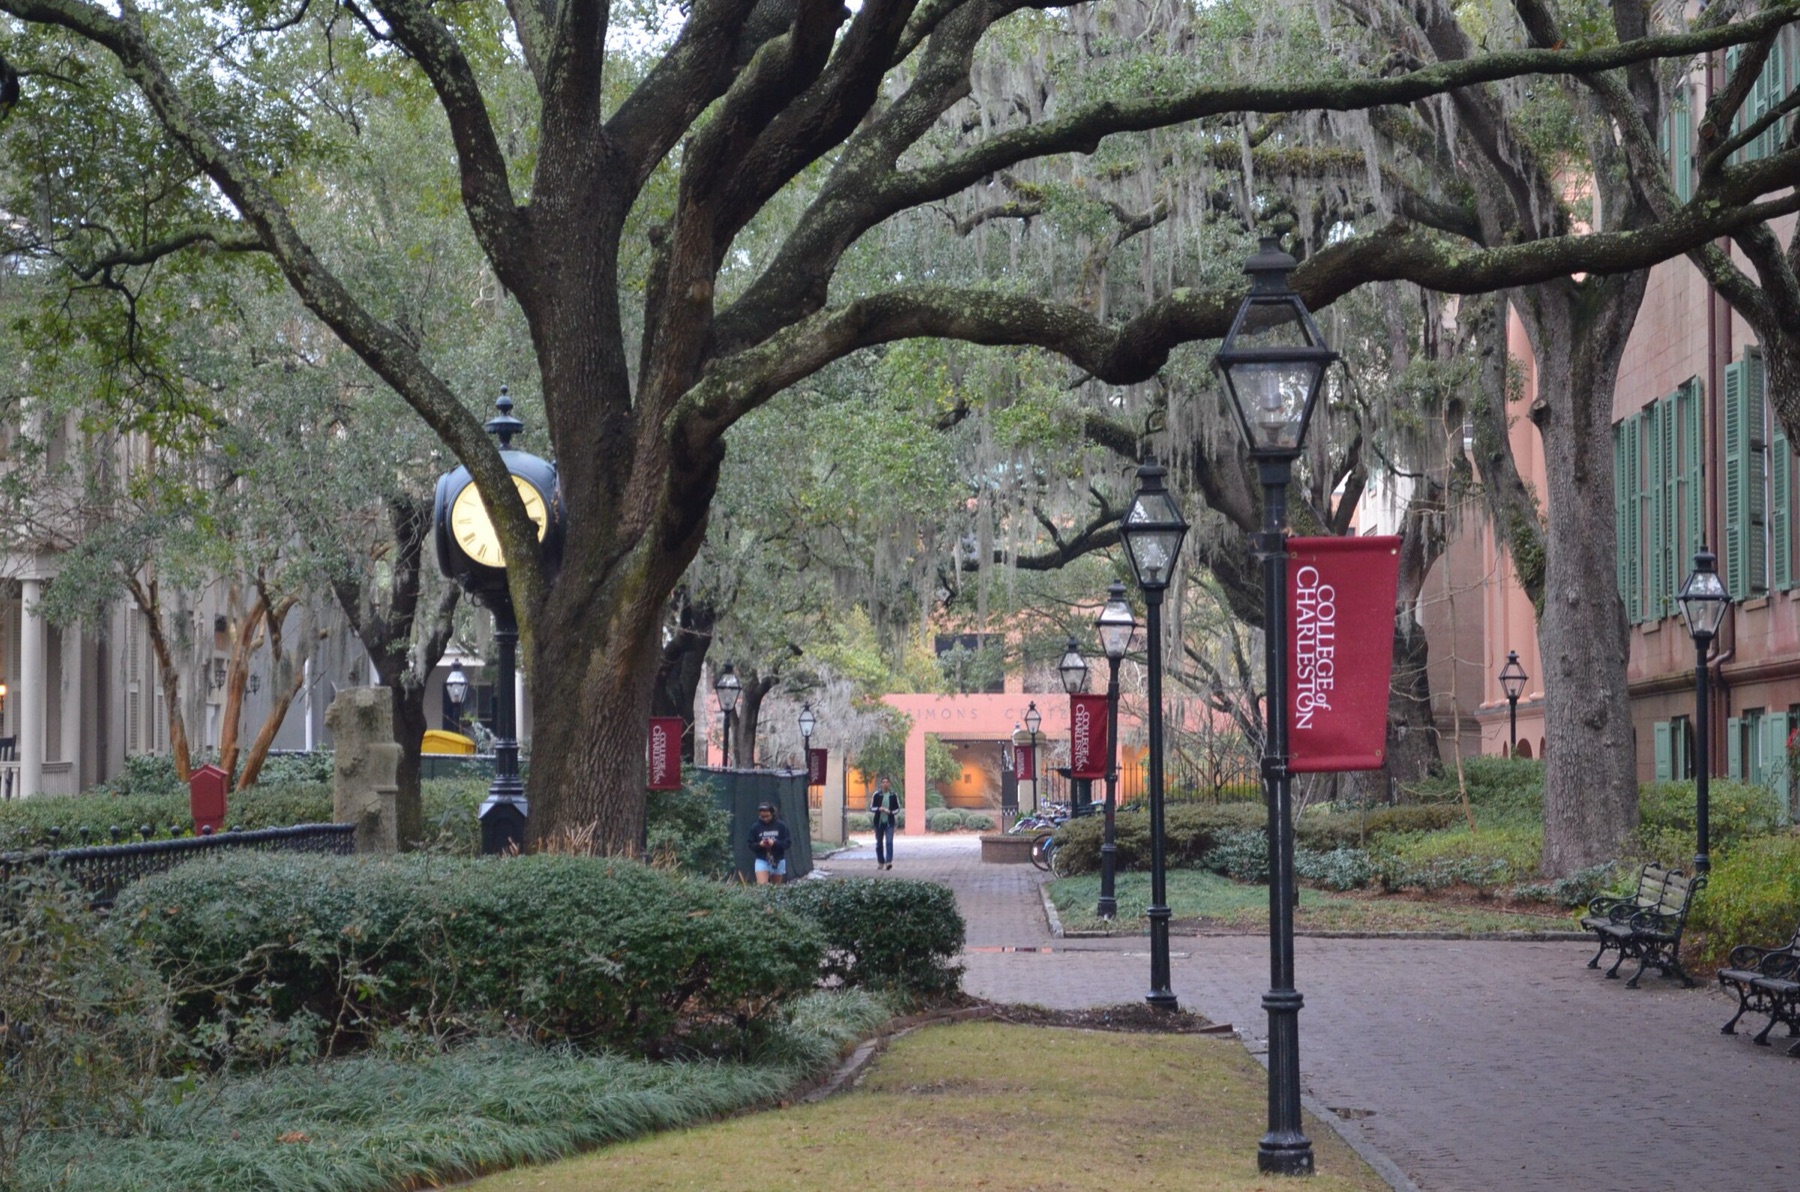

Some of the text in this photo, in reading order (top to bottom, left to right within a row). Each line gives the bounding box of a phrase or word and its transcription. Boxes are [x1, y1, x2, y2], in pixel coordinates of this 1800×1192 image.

[1296, 565, 1319, 730] CHARLESTON
[1304, 584, 1336, 711] COLLEGE of
[1005, 708, 1068, 720] CETE
[1075, 703, 1085, 772] CHARLESTON
